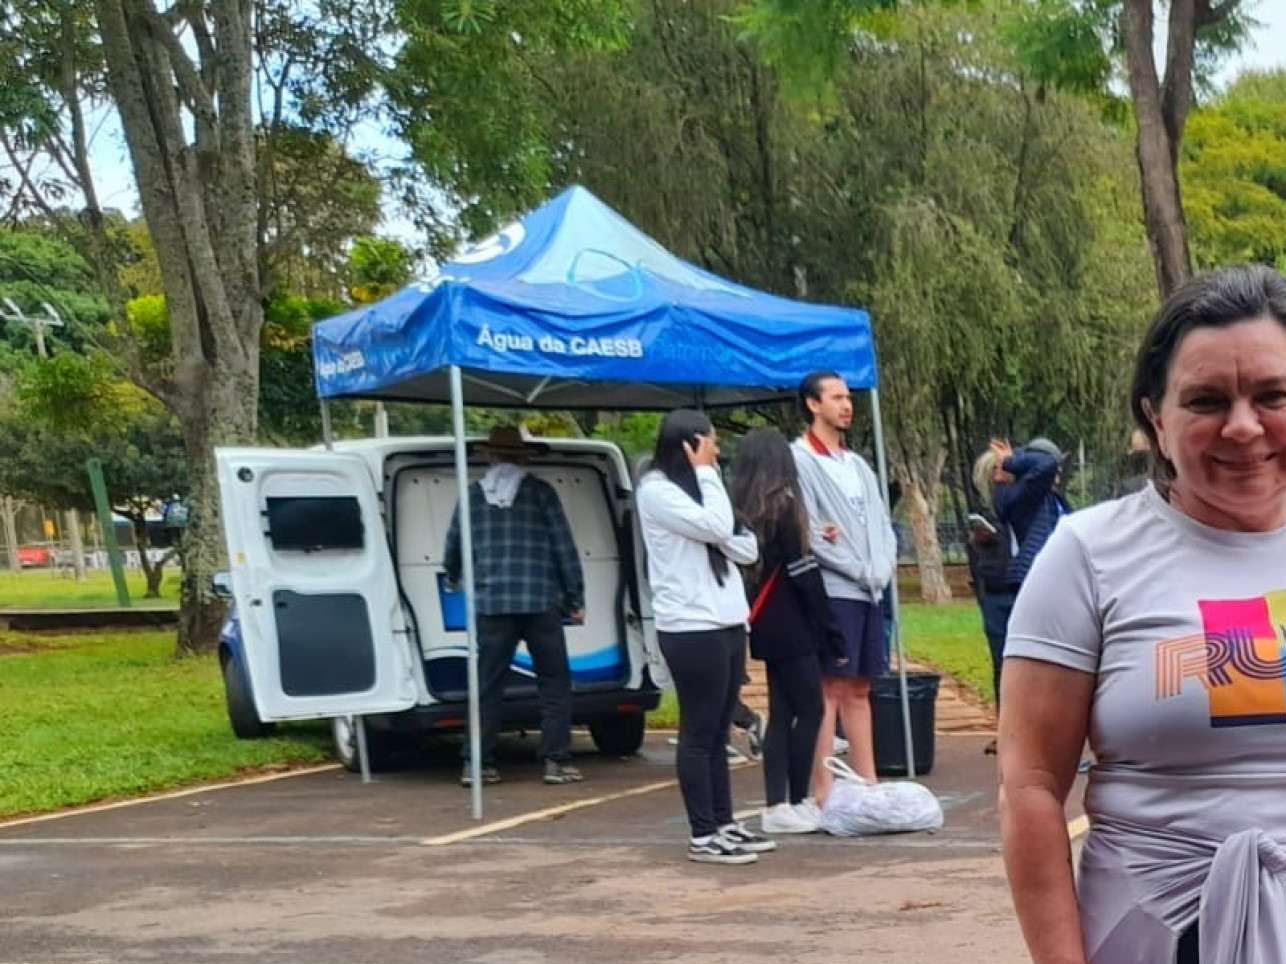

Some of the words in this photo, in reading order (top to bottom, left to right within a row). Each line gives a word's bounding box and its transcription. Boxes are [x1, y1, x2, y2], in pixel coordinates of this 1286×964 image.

[477, 323, 533, 351] Água
[540, 334, 565, 353] da
[571, 337, 643, 357] CAESB
